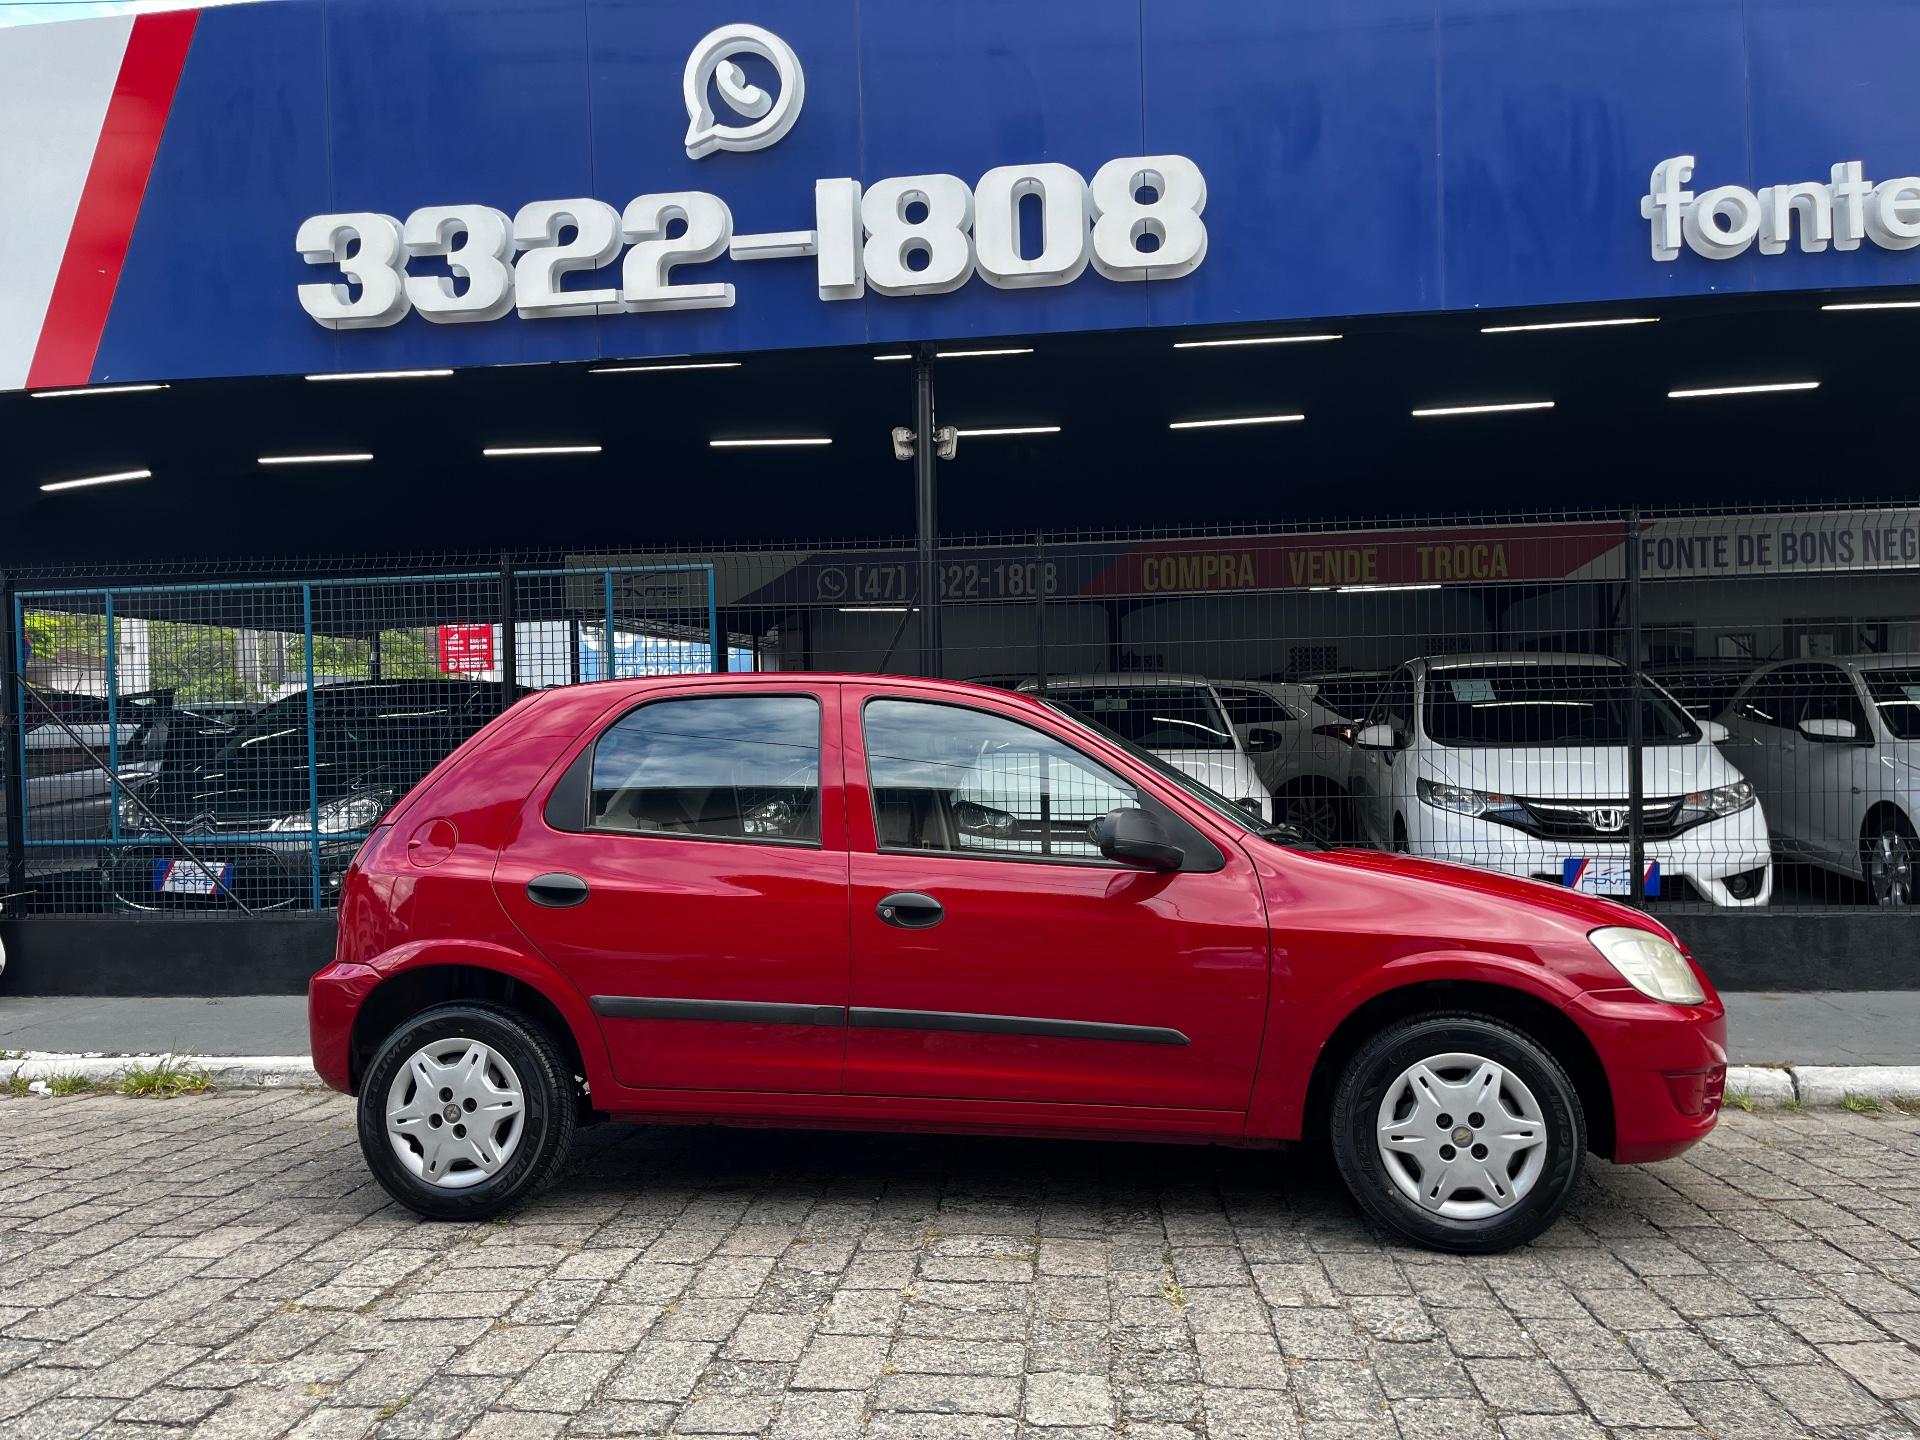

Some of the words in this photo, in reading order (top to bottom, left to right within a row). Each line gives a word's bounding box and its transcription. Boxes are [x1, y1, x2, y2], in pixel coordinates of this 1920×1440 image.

[1641, 155, 1920, 261] fonte
[296, 155, 1208, 330] 3322-1808
[1143, 553, 1256, 592] COMPRA
[1288, 548, 1378, 585] VENDE
[1416, 542, 1509, 580] TROCA
[1641, 536, 1729, 571] FONTE
[1737, 533, 1772, 568] DE
[1781, 529, 1854, 565] BONS
[853, 564, 907, 600] (47)
[917, 562, 1058, 598] 322-1808
